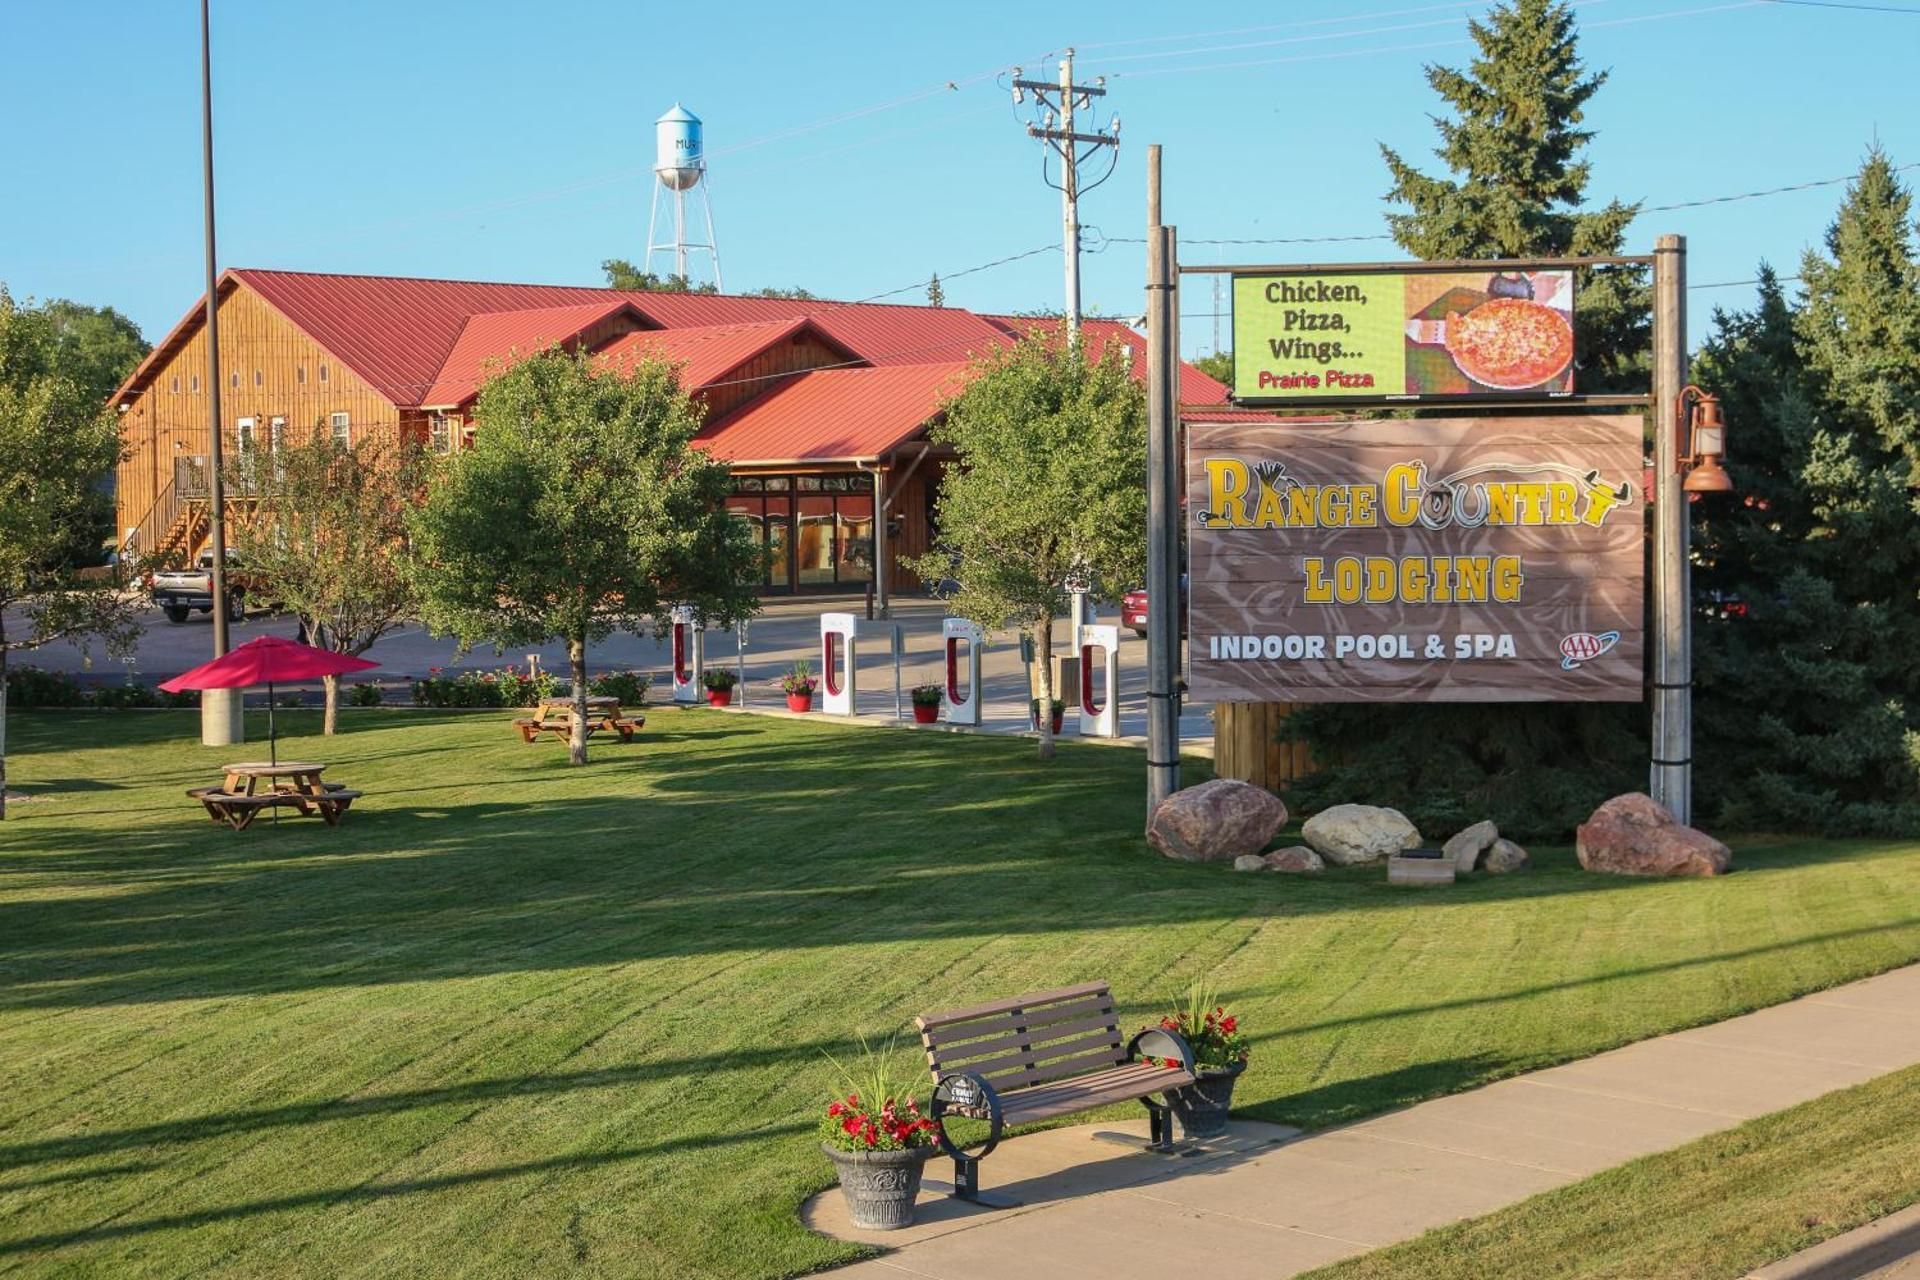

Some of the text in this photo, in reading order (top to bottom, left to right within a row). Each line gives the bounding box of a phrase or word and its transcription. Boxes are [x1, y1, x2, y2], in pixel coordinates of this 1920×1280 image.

[1265, 280, 1367, 305] Chicken,
[1283, 310, 1351, 334] Pizza,
[1269, 338, 1364, 364] Wings...
[1259, 370, 1375, 388] Prairie Pizza
[1204, 457, 1632, 531] RANGE COUNTRY
[1303, 555, 1524, 605] LODGING
[1210, 634, 1517, 659] INDOOR POOL & SPA
[1562, 634, 1601, 660] AAA
